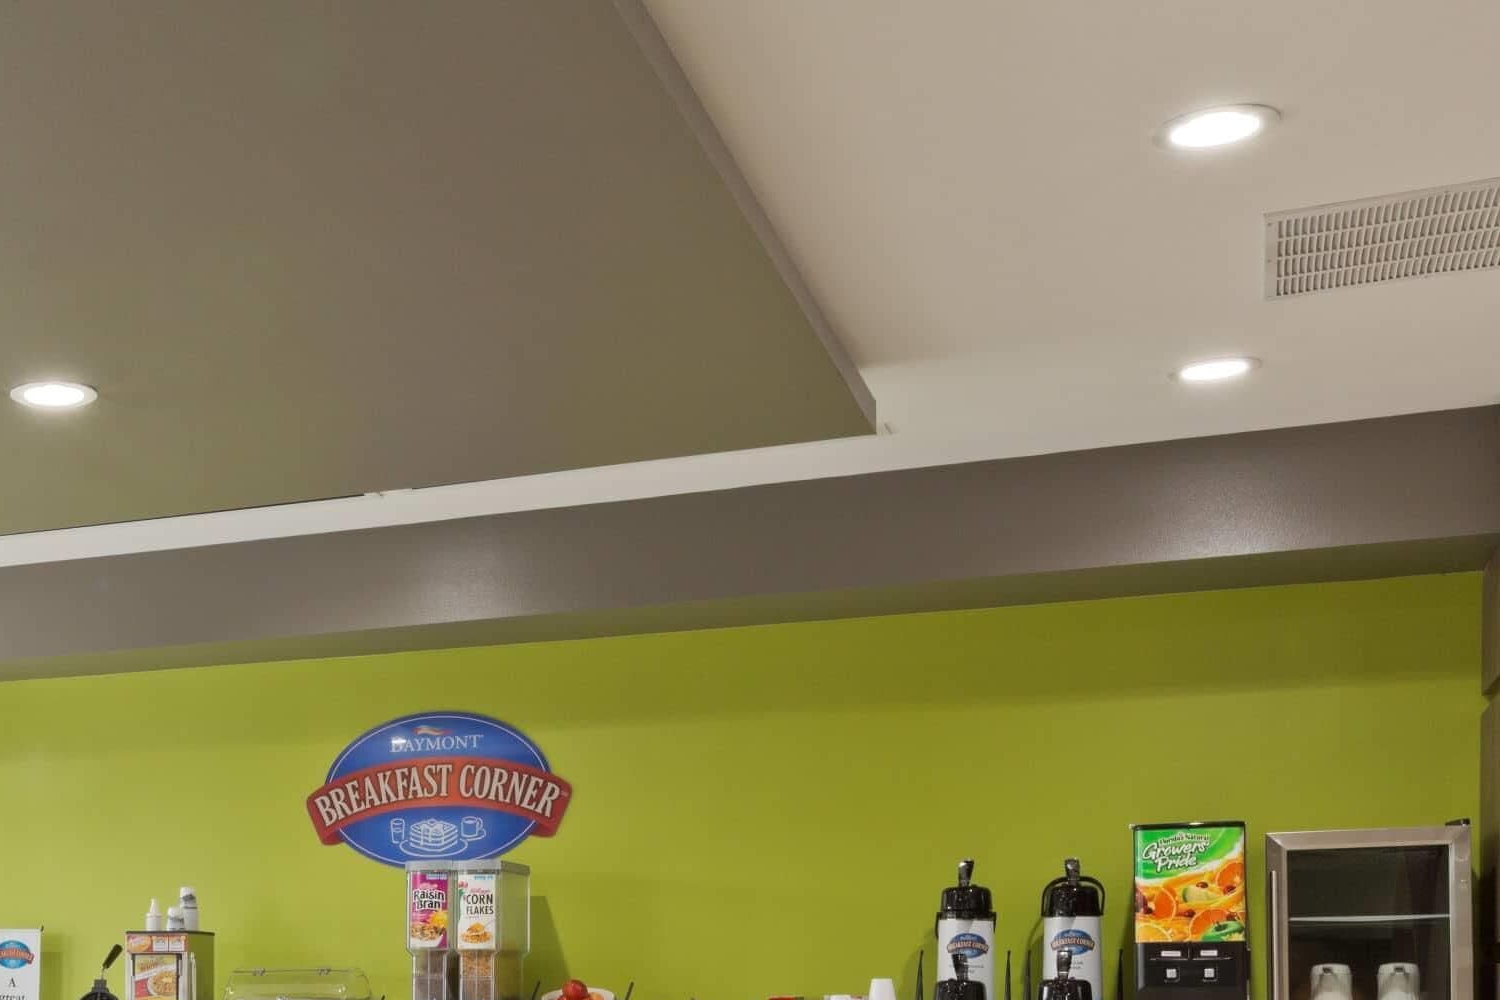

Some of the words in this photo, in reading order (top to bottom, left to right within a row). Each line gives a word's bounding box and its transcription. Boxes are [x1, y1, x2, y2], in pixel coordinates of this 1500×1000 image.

[389, 735, 480, 753] BAYMONT
[314, 764, 453, 827] BREAKFAST
[459, 764, 562, 818] CORNER
[1155, 853, 1197, 873] Pride
[414, 889, 445, 901] Raisin
[466, 894, 494, 905] CORN
[417, 900, 441, 910] Bran
[466, 906, 494, 915] FLAKES
[9, 977, 16, 988] A
